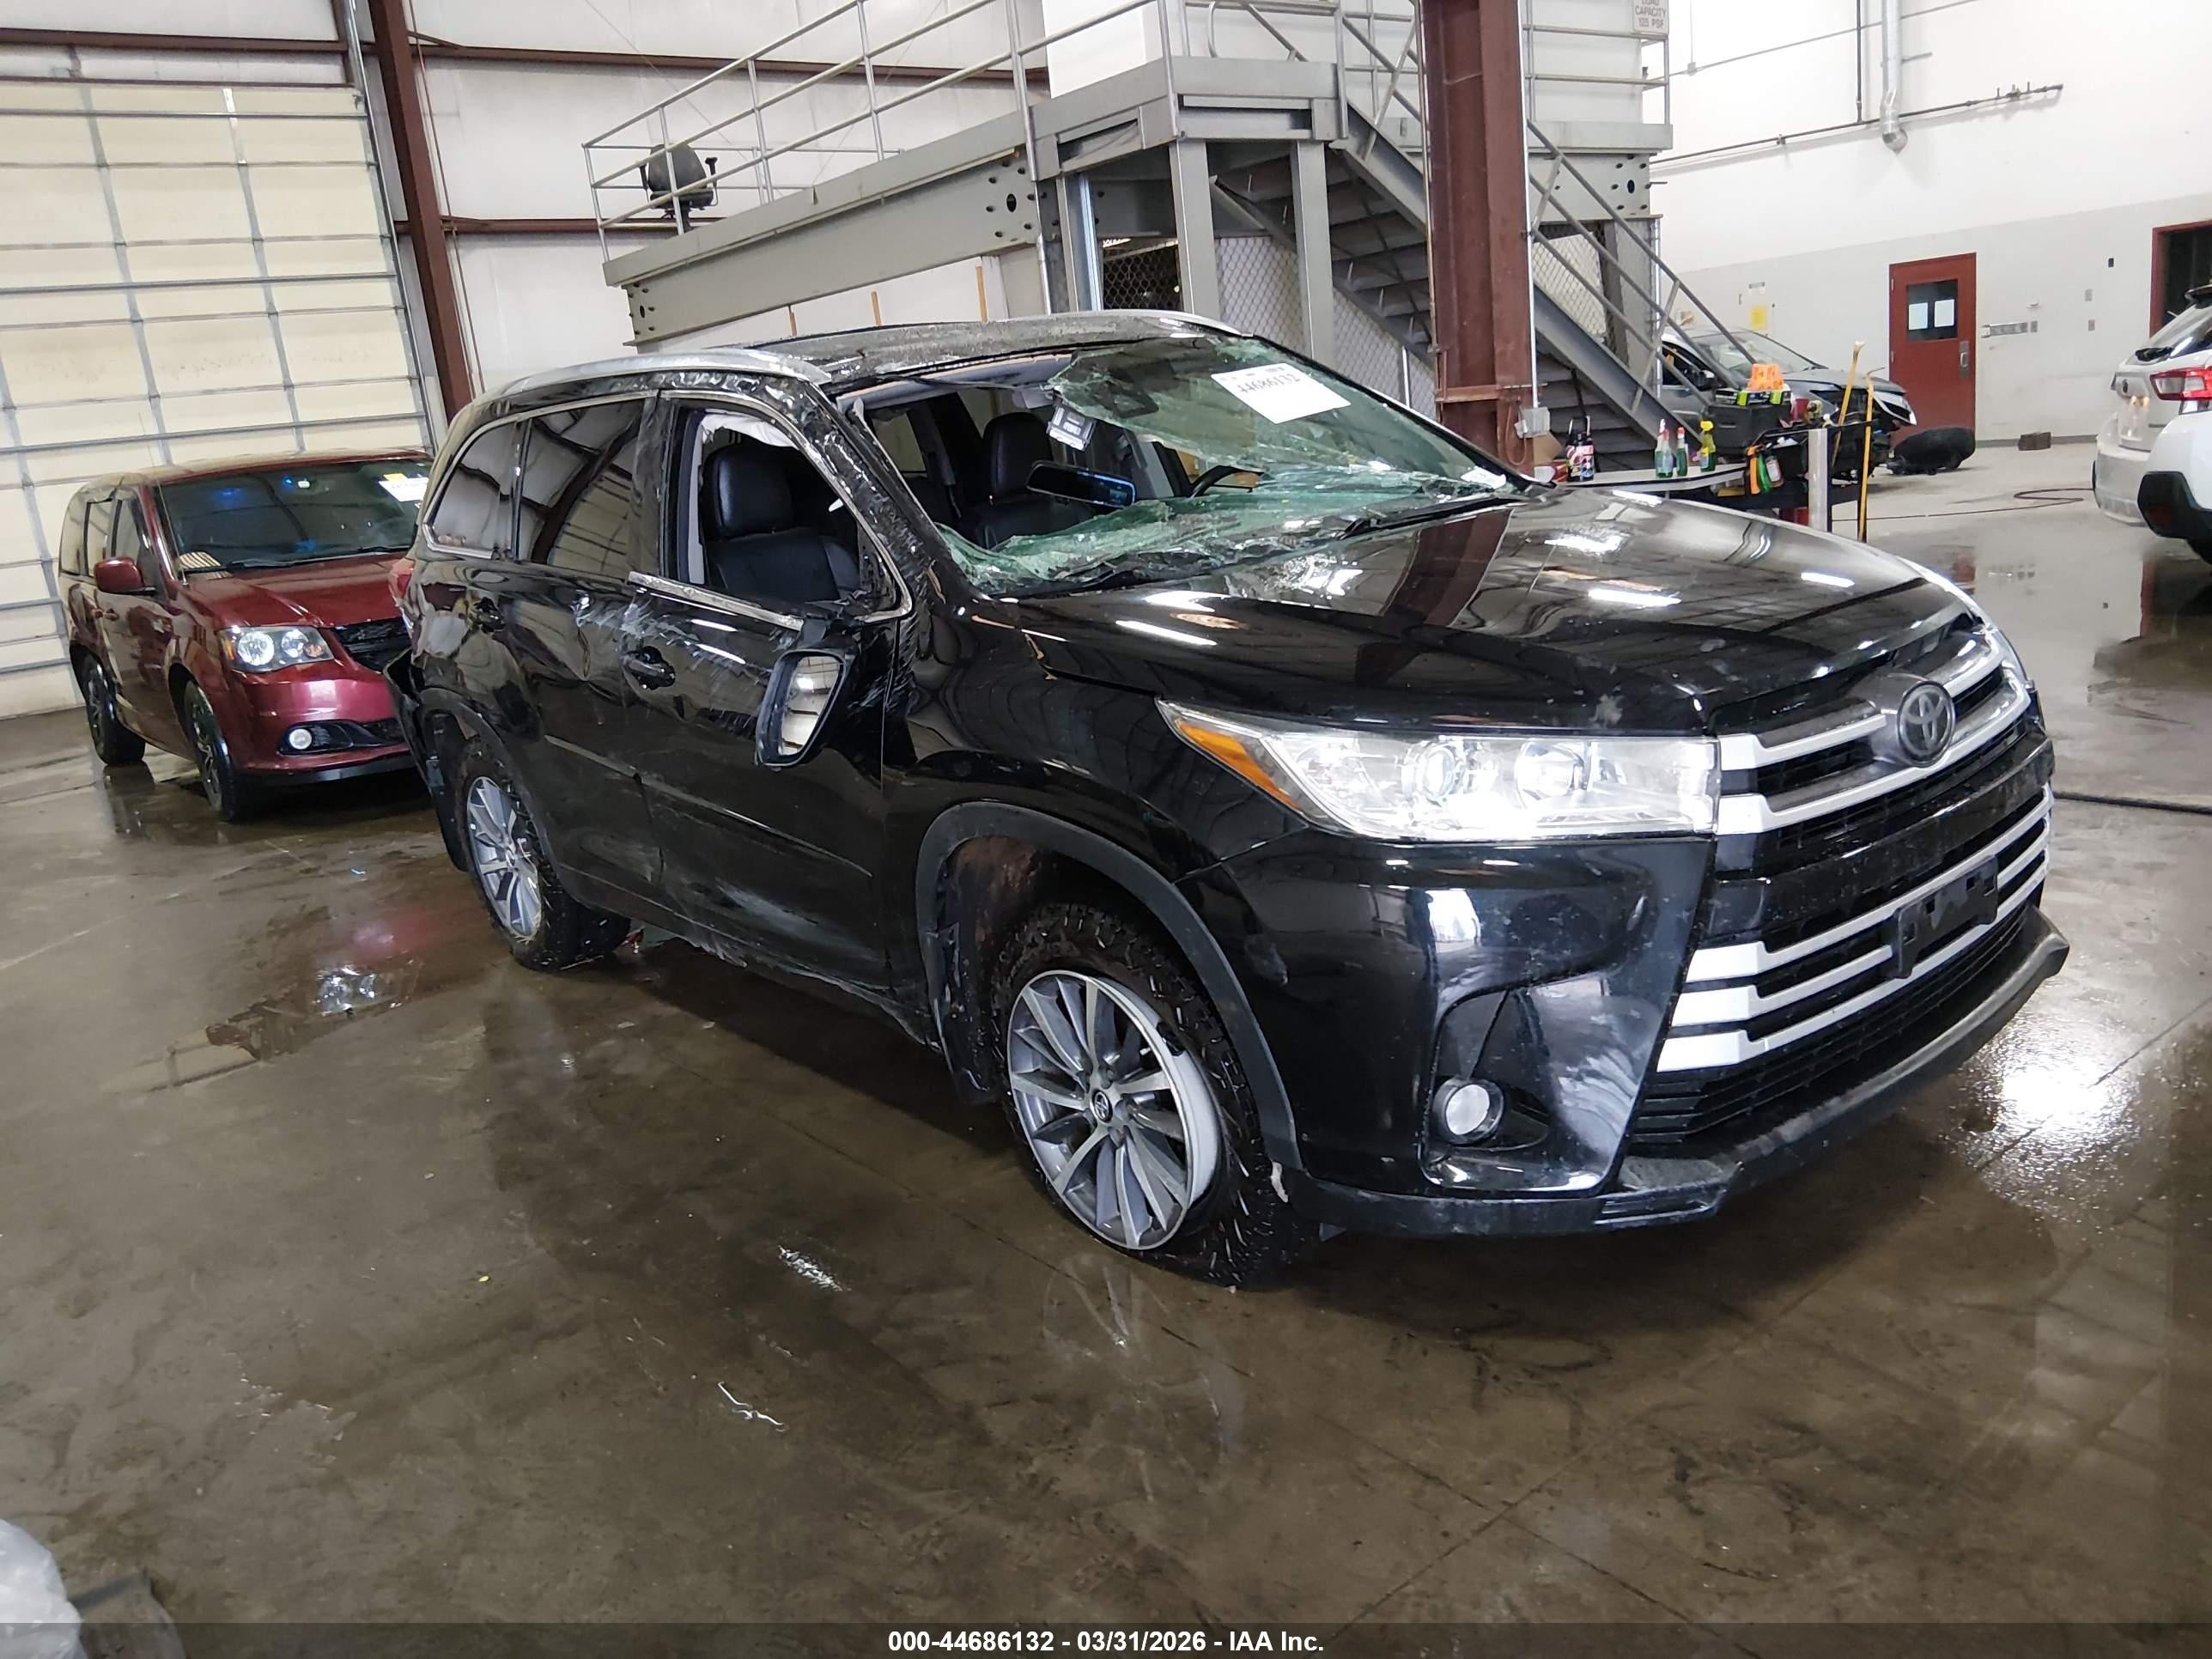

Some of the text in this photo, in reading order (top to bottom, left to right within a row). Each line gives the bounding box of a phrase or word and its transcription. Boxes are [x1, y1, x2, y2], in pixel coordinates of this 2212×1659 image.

[1635, 5, 1666, 17] CAPACITY
[1638, 17, 1664, 28] 125 PSF
[1237, 373, 1301, 393] 44686132
